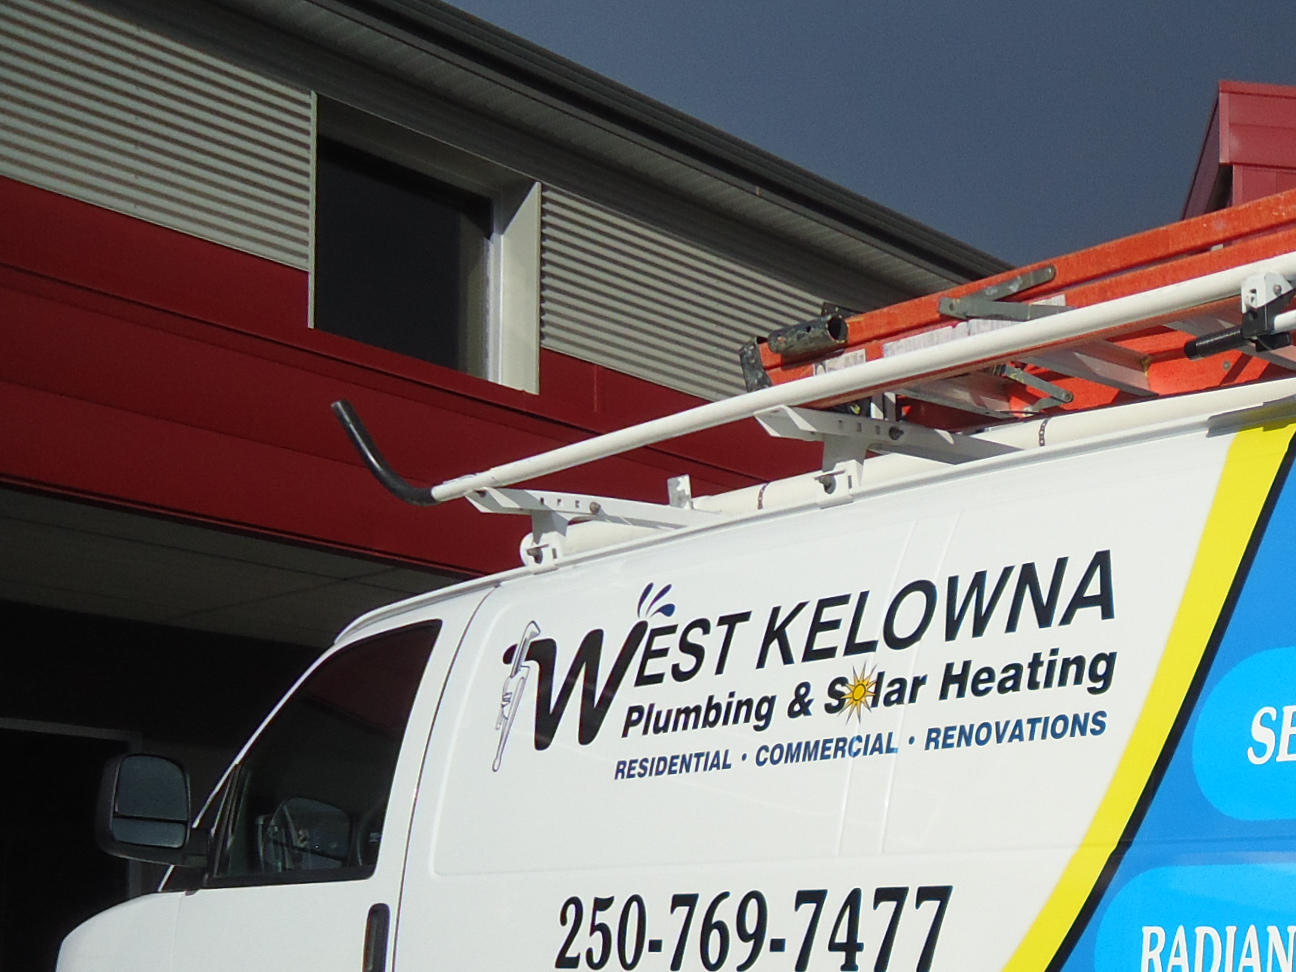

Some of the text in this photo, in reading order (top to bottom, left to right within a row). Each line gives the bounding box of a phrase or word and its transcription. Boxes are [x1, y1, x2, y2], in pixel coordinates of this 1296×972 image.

[503, 549, 1115, 751] WEST KELOWNA
[622, 690, 777, 739] Plumbing
[787, 683, 813, 718] &
[939, 648, 1118, 701] Heating
[614, 710, 1108, 780] RESIDENTIAL COMMERCIAL RENOVATIONS
